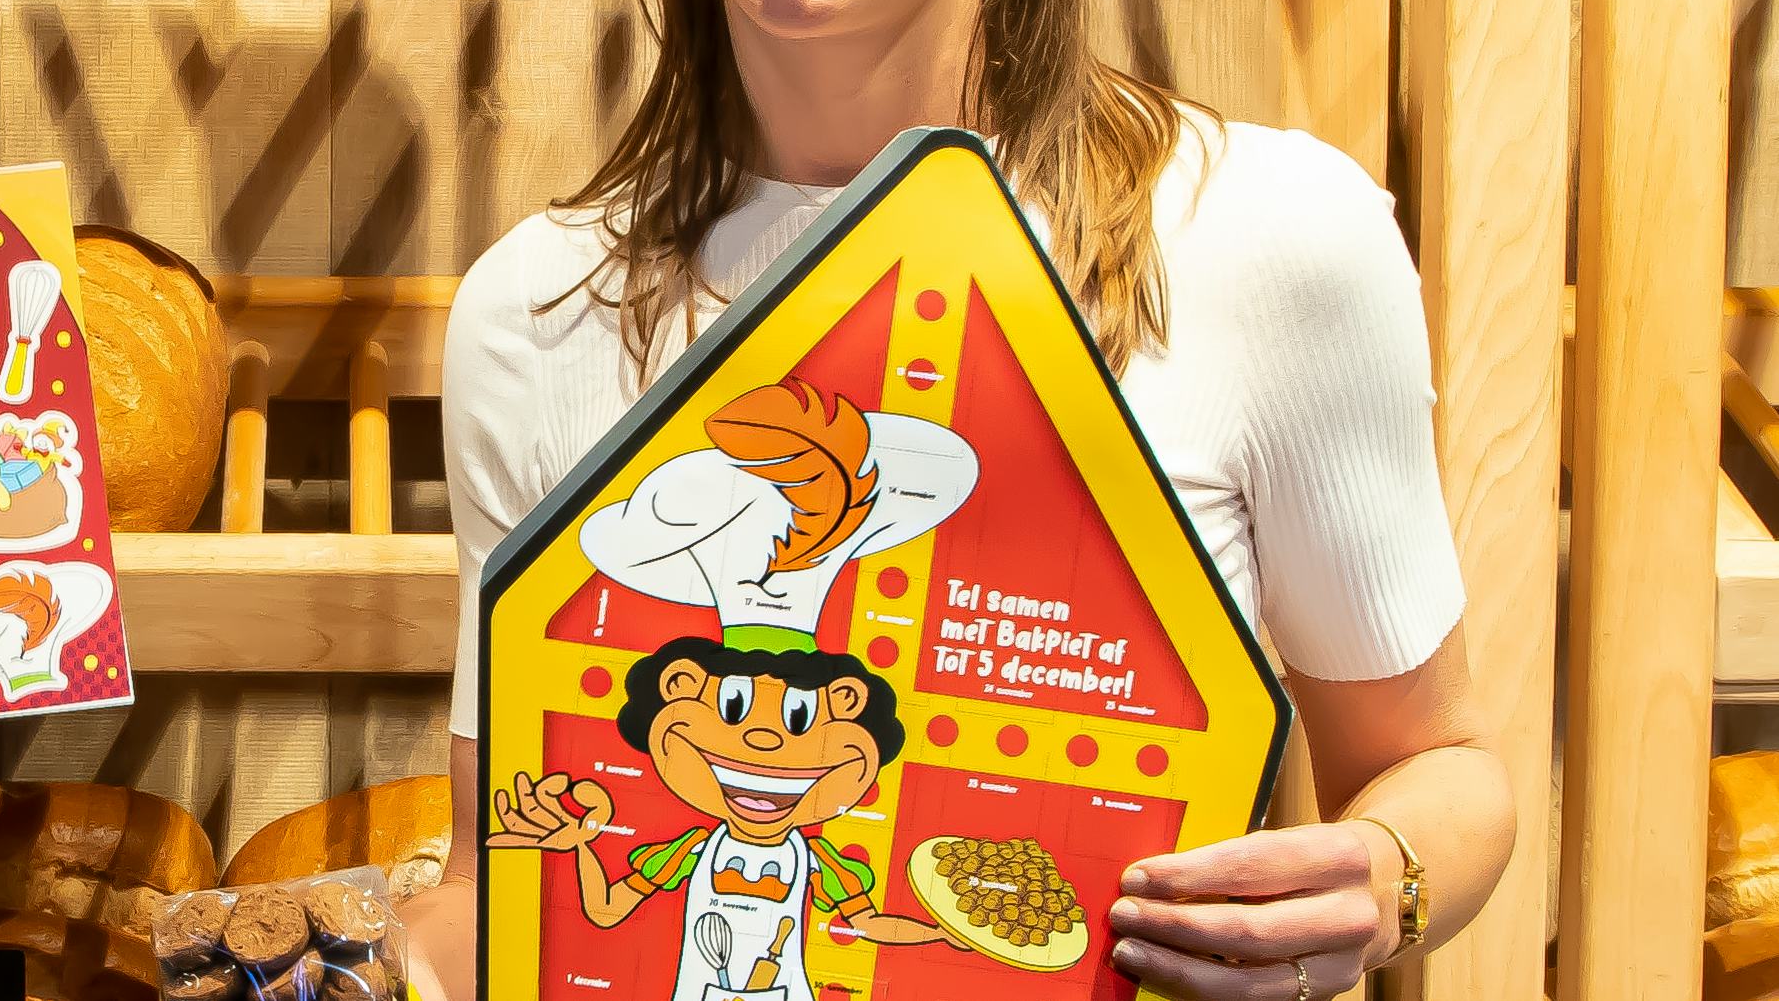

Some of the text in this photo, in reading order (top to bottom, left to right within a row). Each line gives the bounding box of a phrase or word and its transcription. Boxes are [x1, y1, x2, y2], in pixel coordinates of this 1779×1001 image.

[947, 578, 1071, 622] Tel samen
[1098, 638, 1128, 666] af
[976, 649, 994, 677] 5
[1000, 655, 1135, 700] december!
